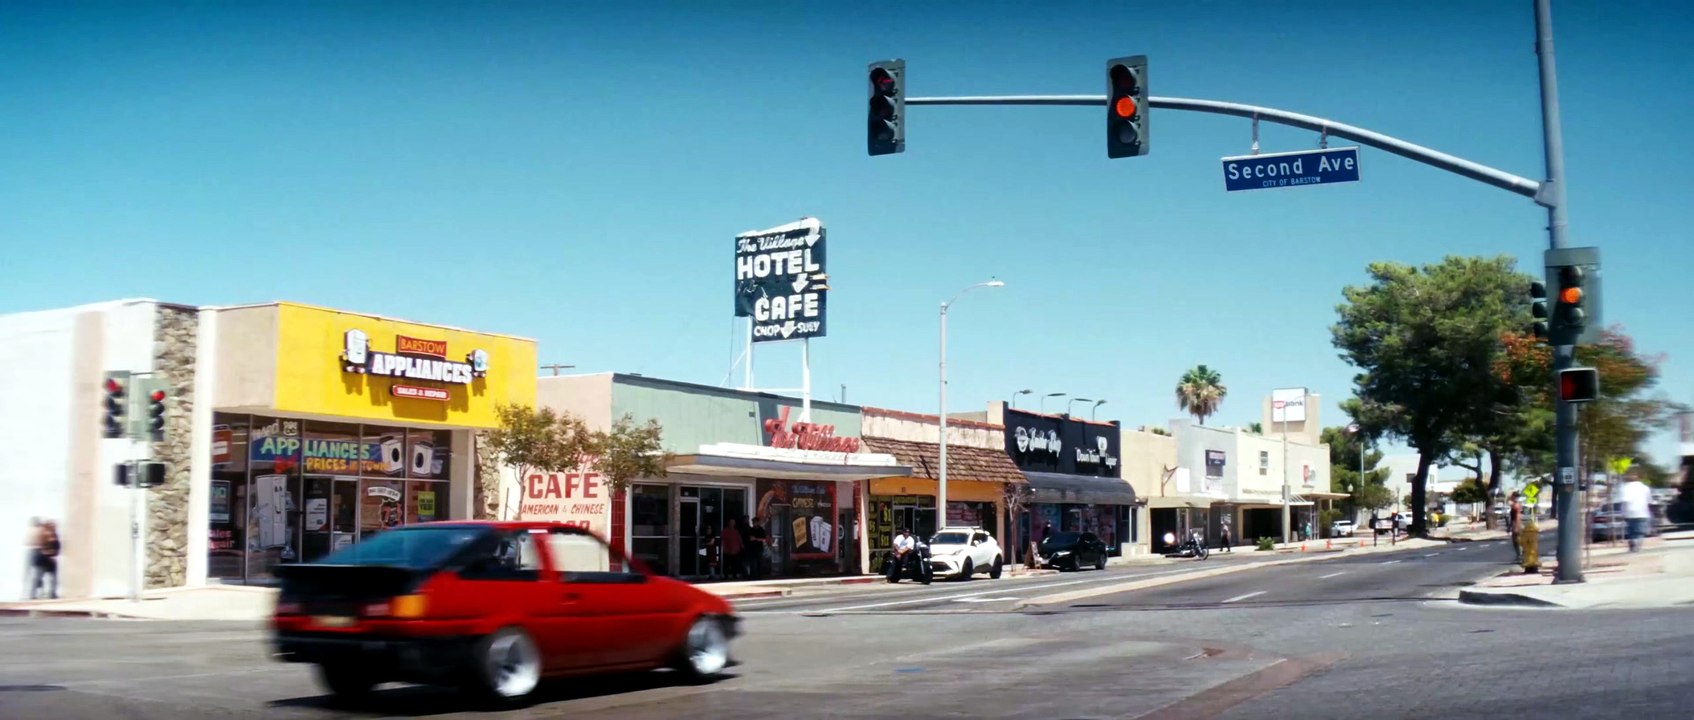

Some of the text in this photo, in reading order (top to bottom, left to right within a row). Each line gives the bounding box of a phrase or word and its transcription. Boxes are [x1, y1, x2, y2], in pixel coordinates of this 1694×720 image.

[1228, 155, 1354, 180] Second Ave
[1290, 177, 1320, 185] BARSTOW
[737, 234, 804, 253] The Village
[737, 248, 819, 280] HOTEL
[755, 293, 818, 321] CAFE
[754, 321, 820, 336] CHOP SUEY
[400, 338, 445, 353] BARSTOW
[372, 354, 472, 383] APPLIANCES
[260, 437, 371, 459] APPLIANCES
[305, 457, 347, 471] PRICES
[528, 473, 599, 499] CAFE
[522, 503, 559, 515] AMERICAN
[570, 503, 605, 514] CHINESE
